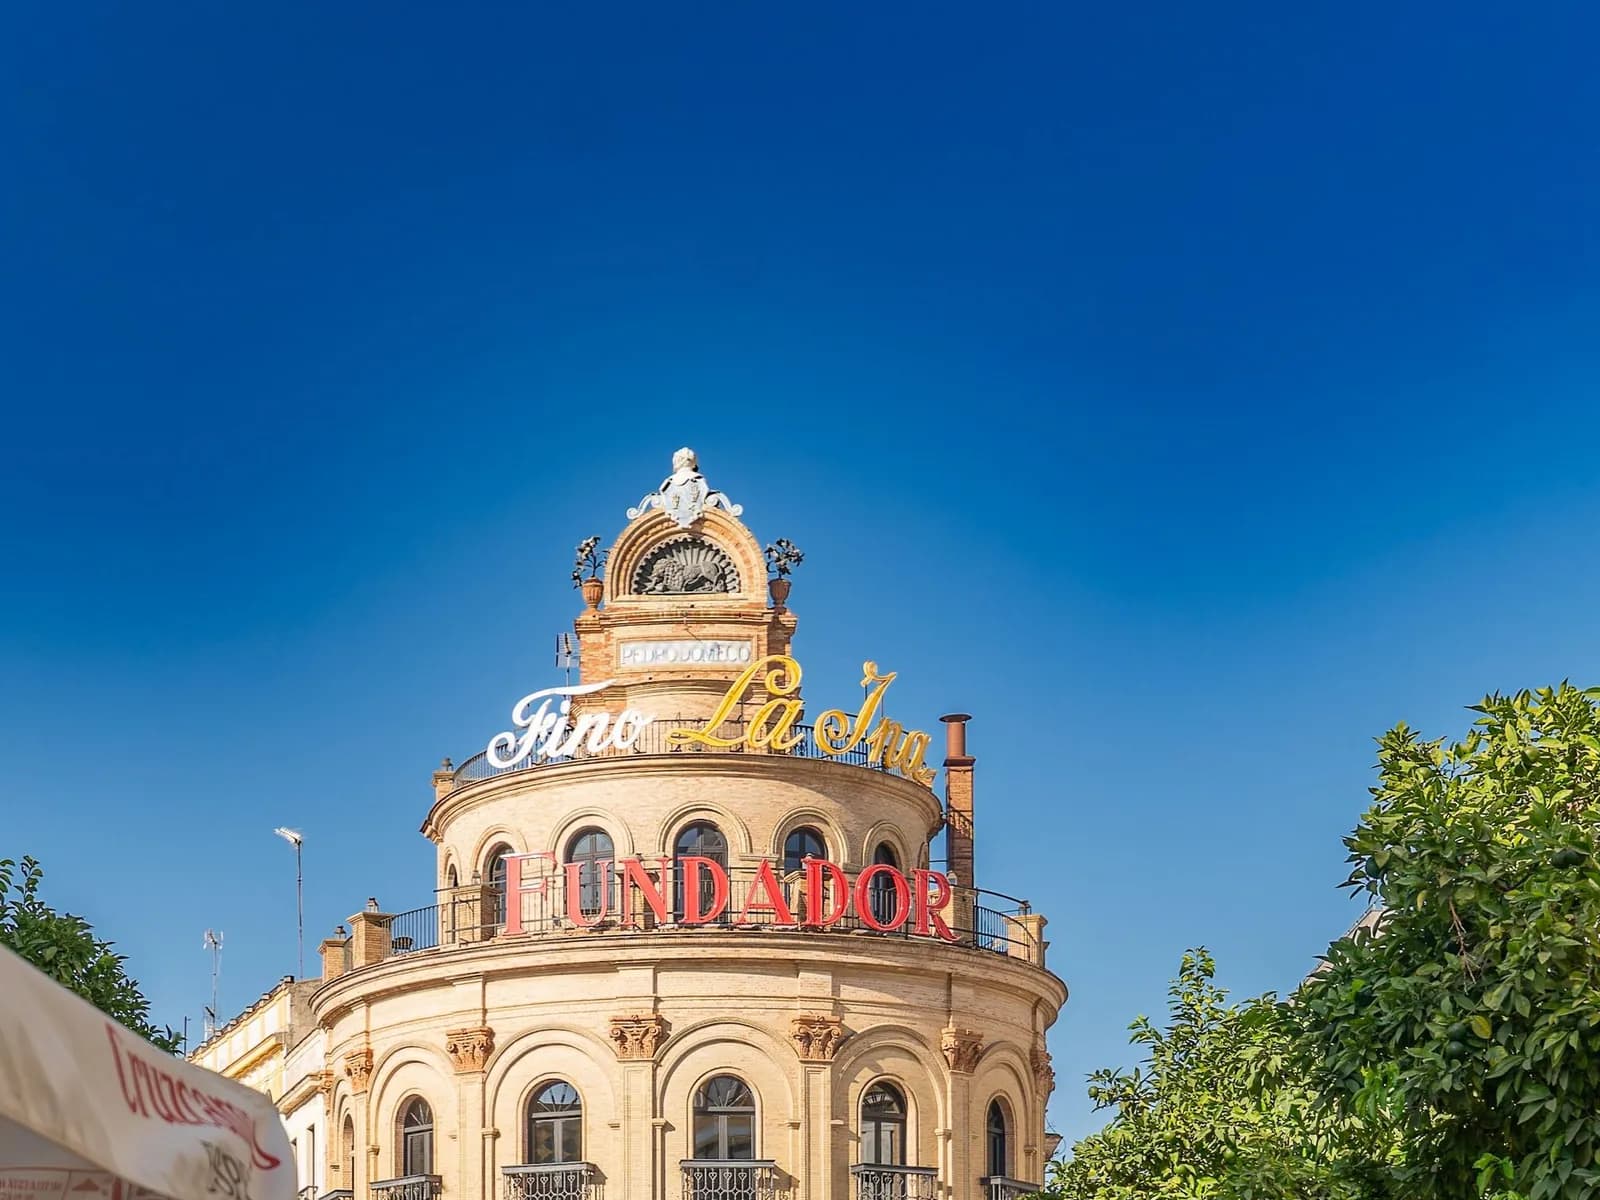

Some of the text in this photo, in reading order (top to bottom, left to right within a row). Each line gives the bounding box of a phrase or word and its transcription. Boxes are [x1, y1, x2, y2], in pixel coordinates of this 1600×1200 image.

[623, 645, 679, 665] PEDRO
[486, 655, 937, 787] Fino La Ina
[501, 850, 961, 943] FUNDADOR
